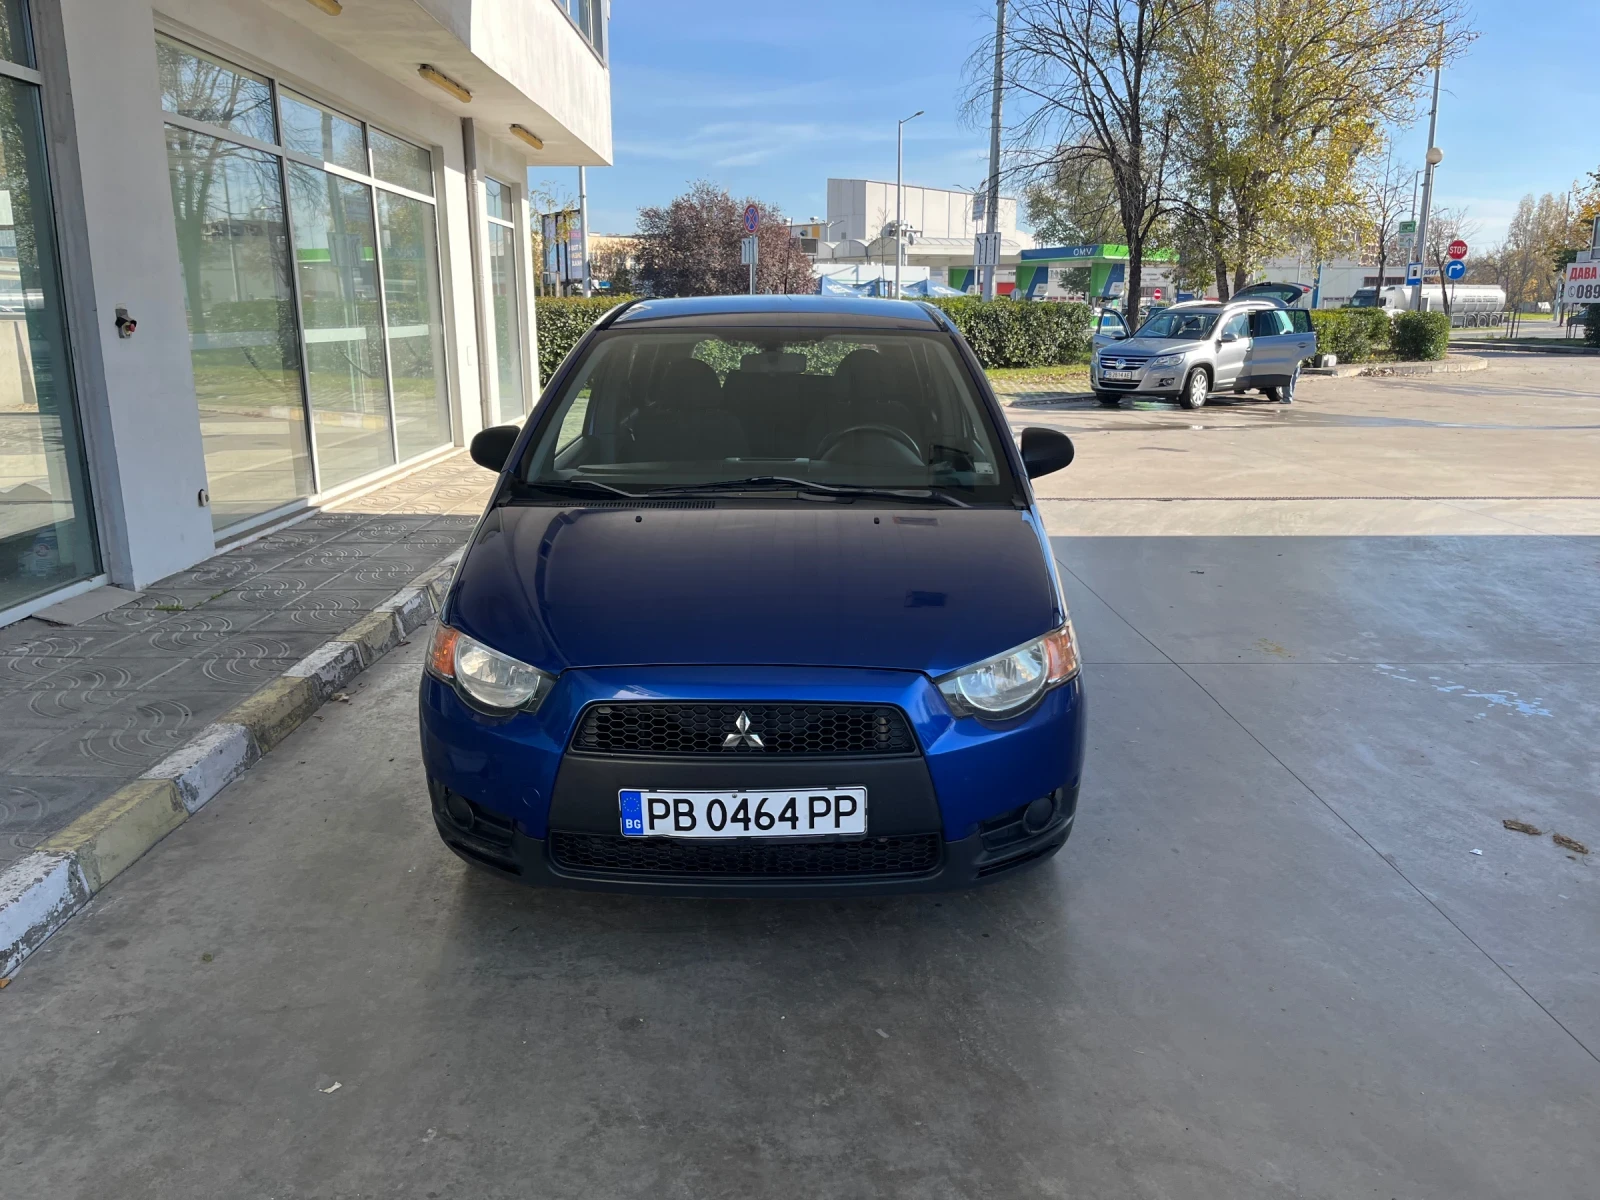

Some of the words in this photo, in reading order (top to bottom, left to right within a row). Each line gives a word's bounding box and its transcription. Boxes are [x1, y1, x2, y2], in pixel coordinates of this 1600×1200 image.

[1073, 248, 1092, 256] OMV
[1450, 246, 1466, 254] STOP
[1569, 266, 1597, 281] ДАВА
[647, 797, 697, 832] PB
[706, 797, 799, 832] 0464
[808, 795, 857, 829] PP
[625, 818, 641, 829] BG
